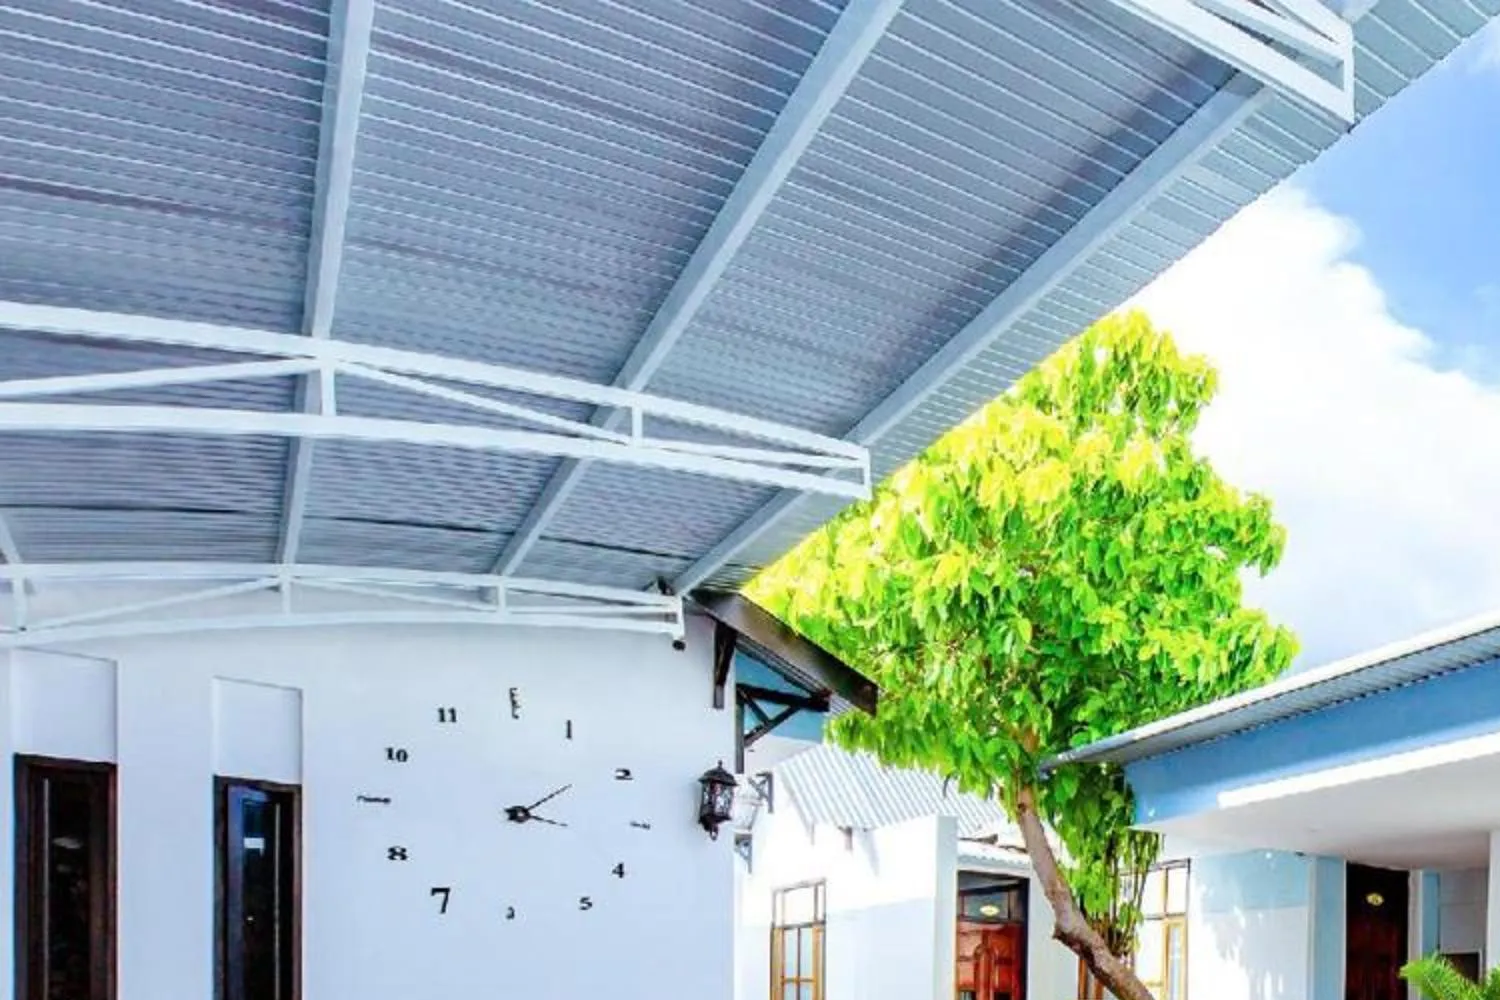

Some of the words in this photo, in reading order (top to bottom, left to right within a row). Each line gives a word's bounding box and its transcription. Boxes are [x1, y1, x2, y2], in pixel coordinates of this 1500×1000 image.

[438, 707, 458, 724] 11
[385, 746, 409, 763] 10
[614, 767, 634, 781] 2
[386, 845, 409, 862] 8
[611, 862, 626, 879] 4
[430, 886, 452, 915] 7
[578, 896, 593, 911] 5
